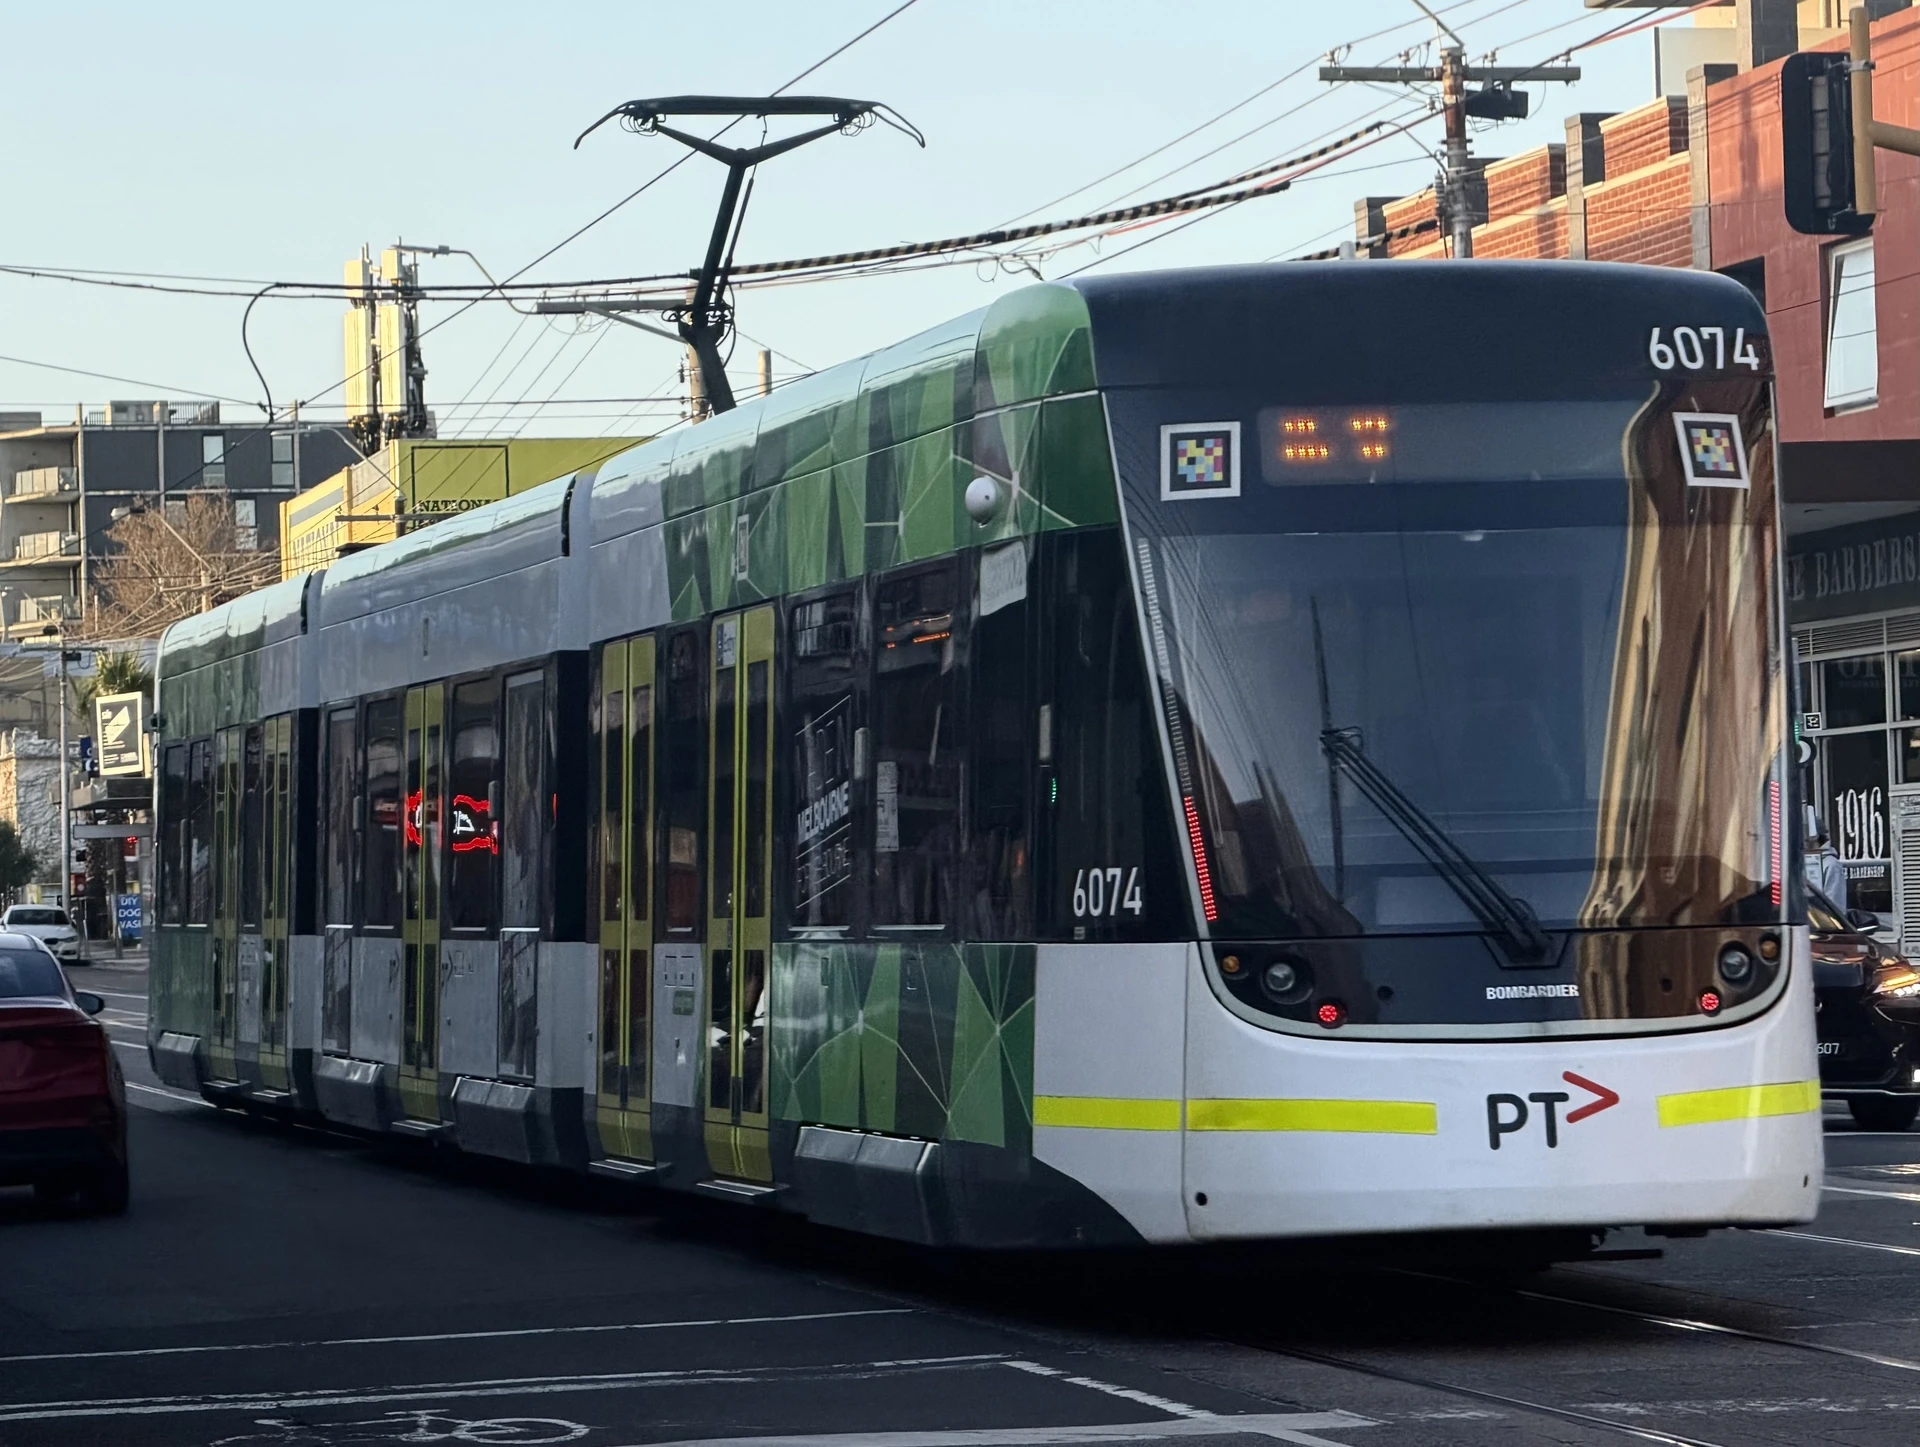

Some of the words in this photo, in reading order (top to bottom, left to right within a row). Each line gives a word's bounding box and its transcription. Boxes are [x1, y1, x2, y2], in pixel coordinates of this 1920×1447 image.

[1649, 326, 1760, 370] 6074
[419, 499, 502, 512] NATION
[1815, 532, 1920, 599] BARBERS
[797, 780, 849, 844] MELBOURNE
[1835, 786, 1884, 861] 1916
[118, 908, 141, 917] DOG
[120, 897, 138, 906] DIY
[1073, 866, 1143, 917] 6074
[1486, 984, 1579, 1000] BOMBARDIER
